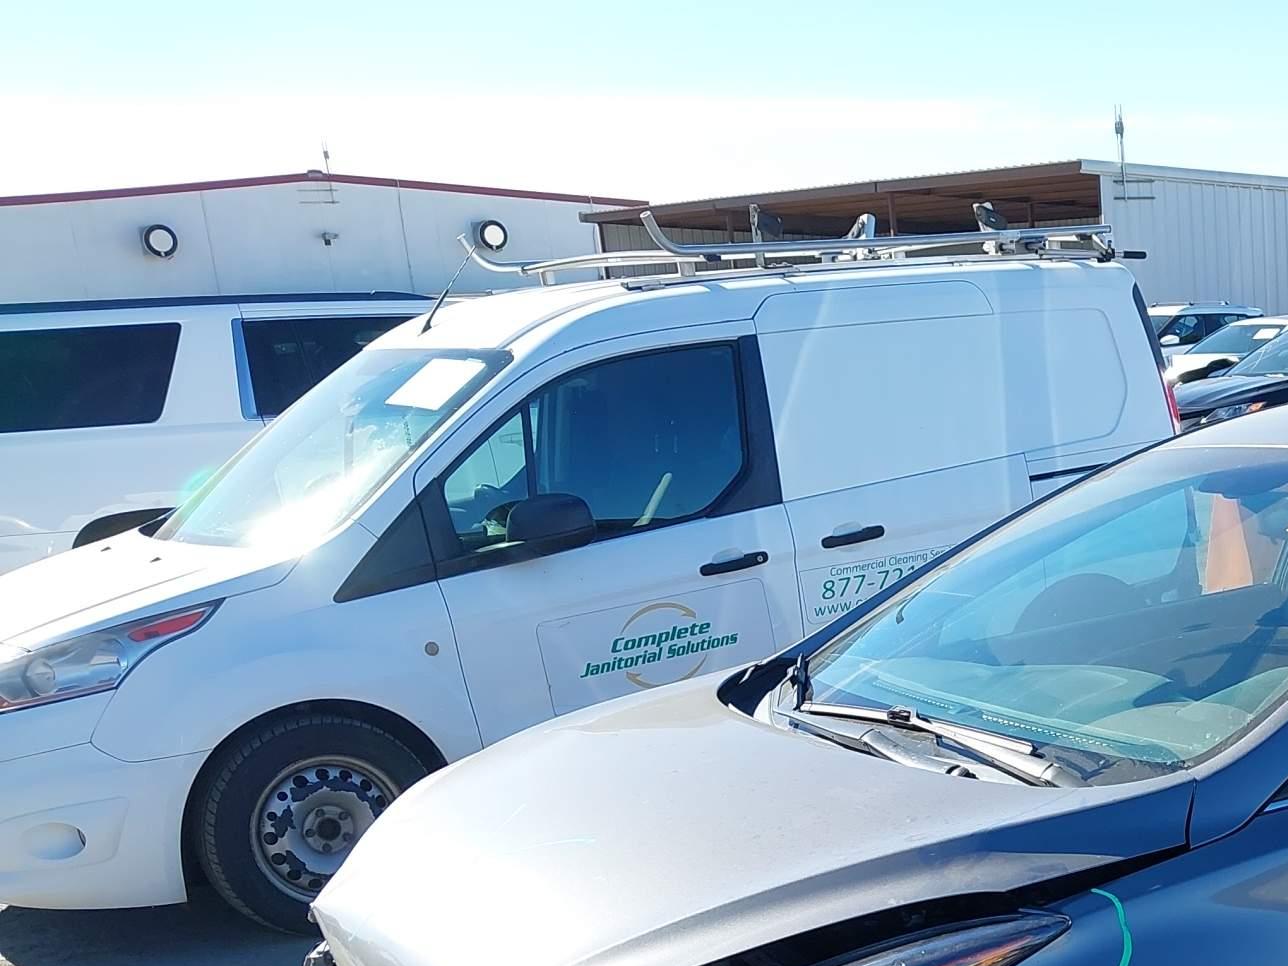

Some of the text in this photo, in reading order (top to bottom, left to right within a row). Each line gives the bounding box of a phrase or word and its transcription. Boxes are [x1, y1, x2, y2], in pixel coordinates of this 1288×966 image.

[830, 559, 887, 577] Commercial
[888, 552, 928, 567] Cleaning
[822, 565, 915, 600] 877-72
[611, 621, 711, 654] Complete
[580, 632, 739, 679] Janitorial Solutions
